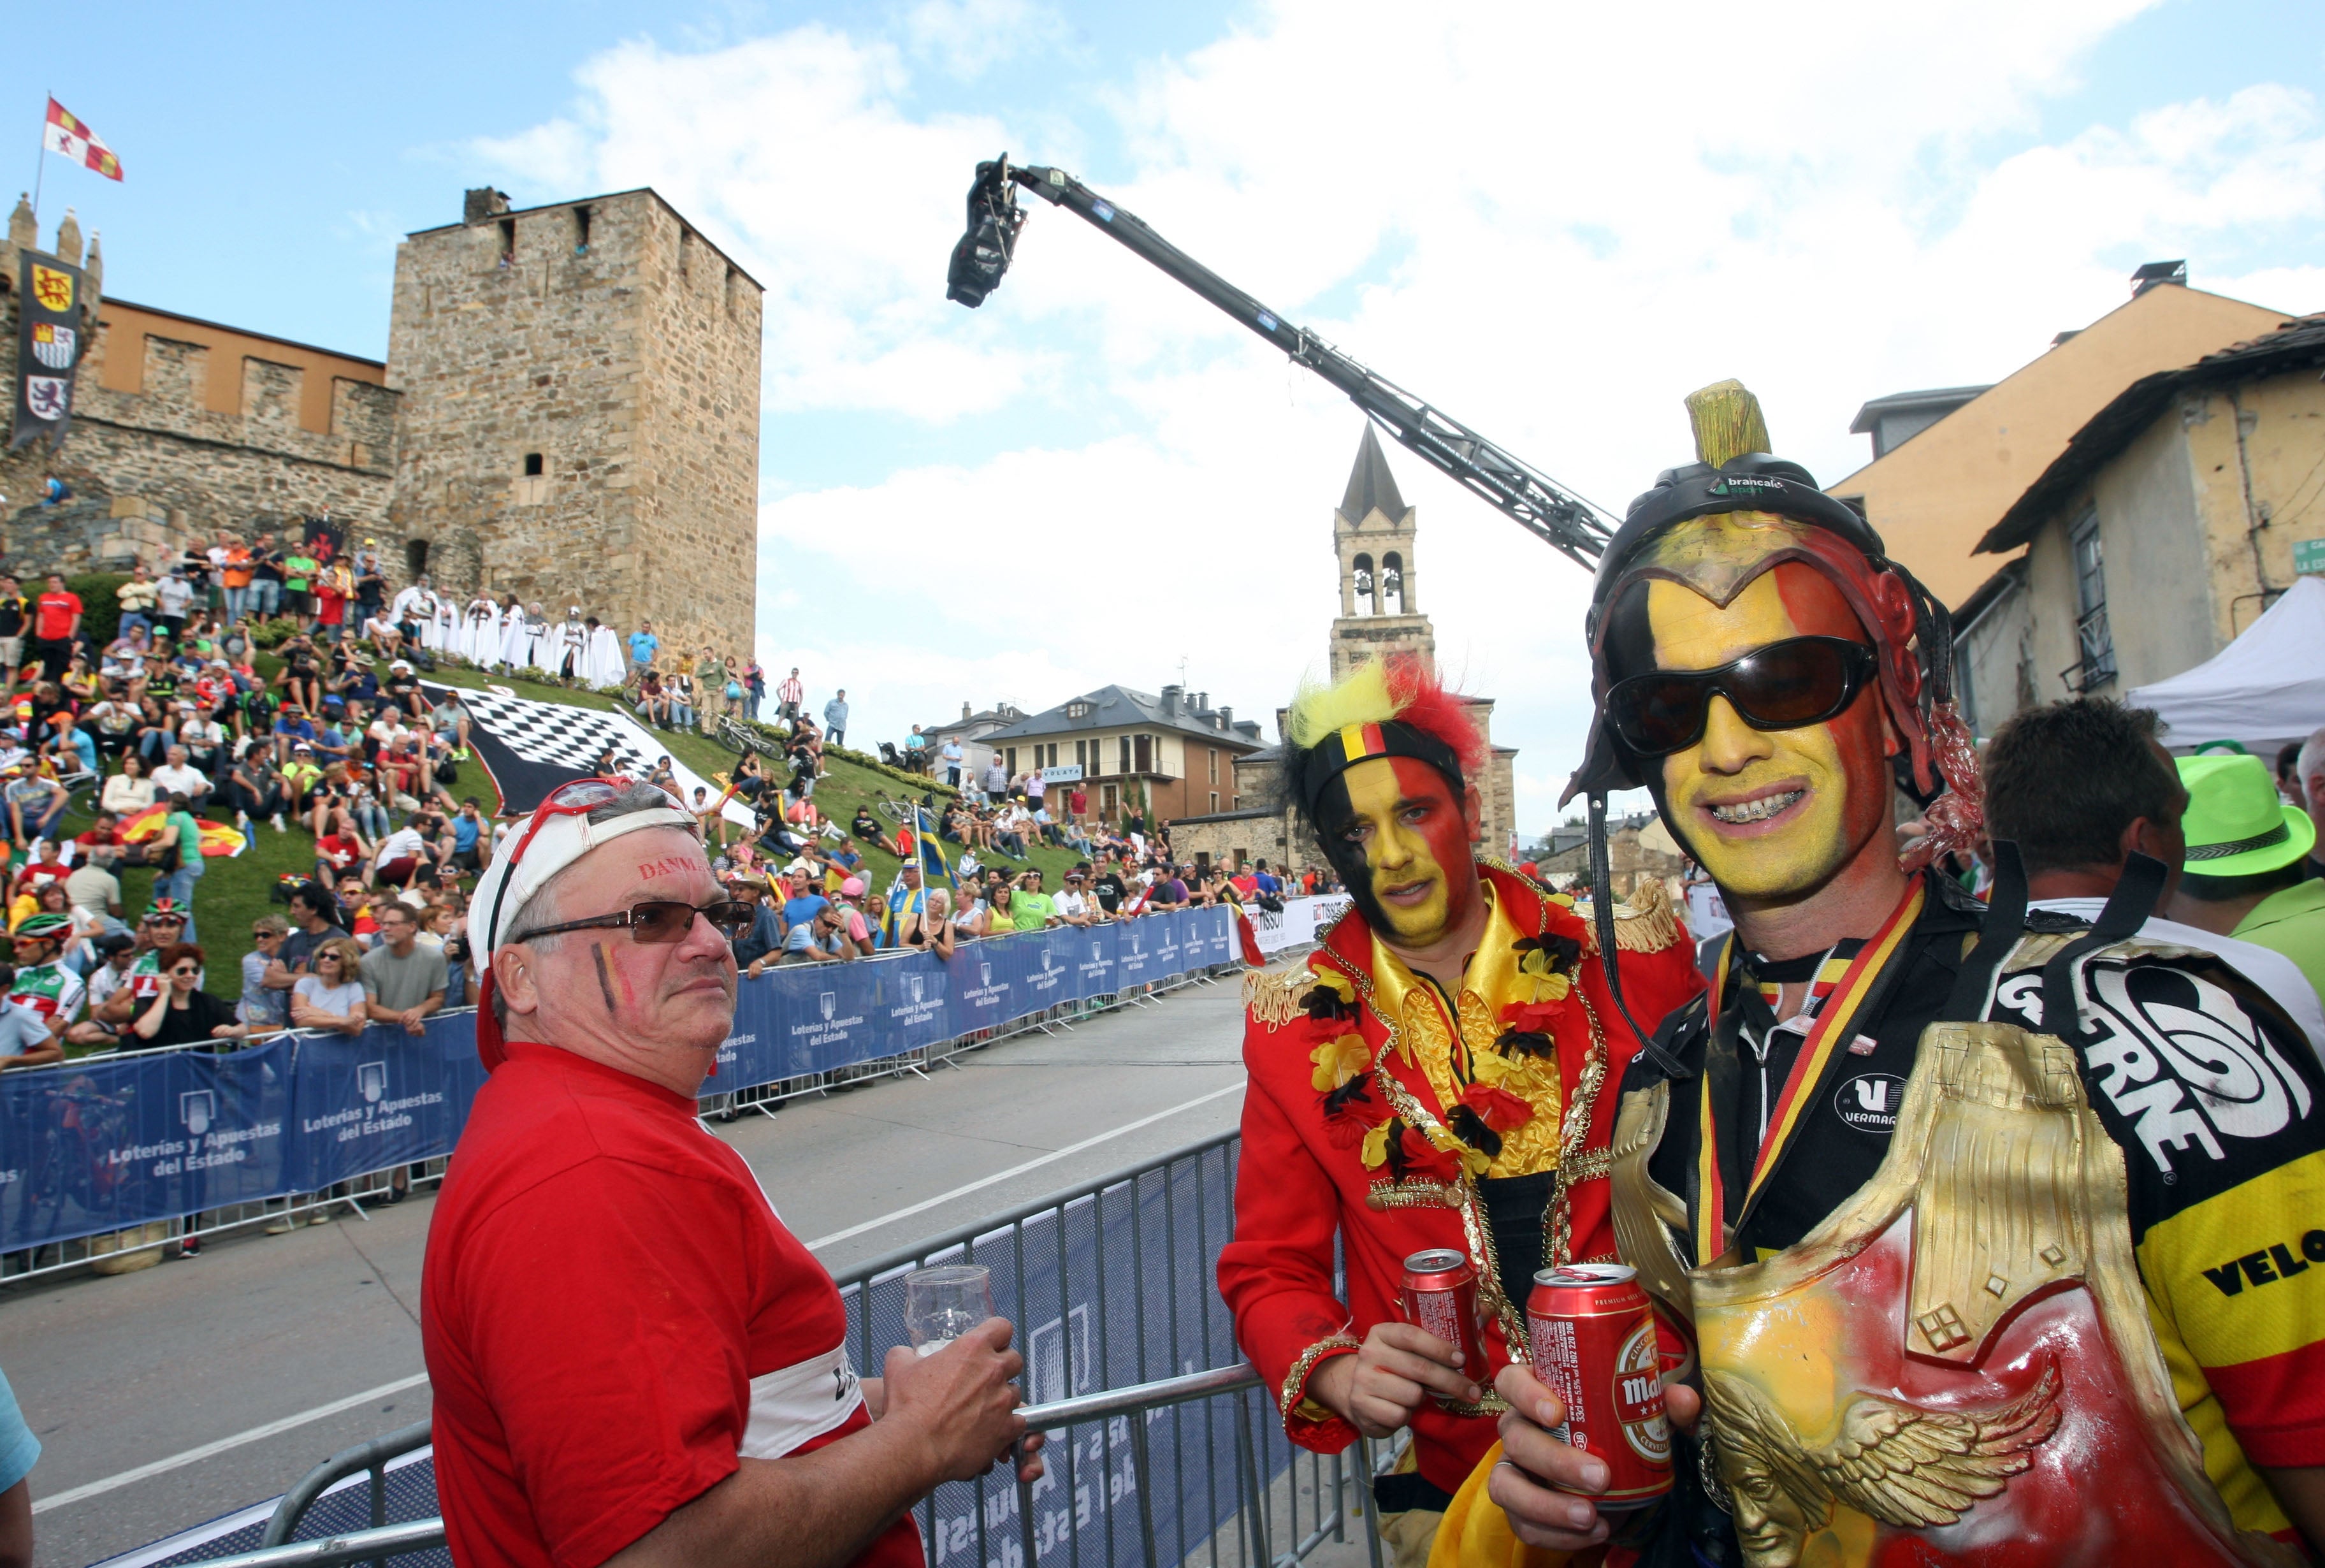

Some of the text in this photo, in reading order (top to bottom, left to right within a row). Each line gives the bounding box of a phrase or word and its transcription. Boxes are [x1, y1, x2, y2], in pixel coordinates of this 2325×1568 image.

[1731, 485, 1764, 494] sport
[1258, 911, 1284, 931] TISSOT
[919, 998, 944, 1012] Apuestas
[824, 1022, 829, 1033] y
[830, 1015, 863, 1030] Apuestas
[904, 1012, 933, 1026] del Estado
[720, 1033, 756, 1050] puestas
[810, 1030, 848, 1046] del Estado
[716, 1050, 737, 1063] tado
[303, 1091, 443, 1133] Loterías y Apuestas
[1845, 1112, 1897, 1125] VERMAR
[338, 1114, 412, 1142] del Estado
[108, 1122, 281, 1164] Loterías y Apuestas
[153, 1148, 246, 1177] del Estado
[1595, 1296, 1626, 1306] PREMIUM
[1565, 1321, 1578, 1364] 902 220 200
[1630, 1335, 1649, 1360] CINCO
[1565, 1372, 1575, 1421] www.mahou.es
[1621, 1370, 1663, 1405] Mah
[1575, 1405, 1586, 1423] 33cl
